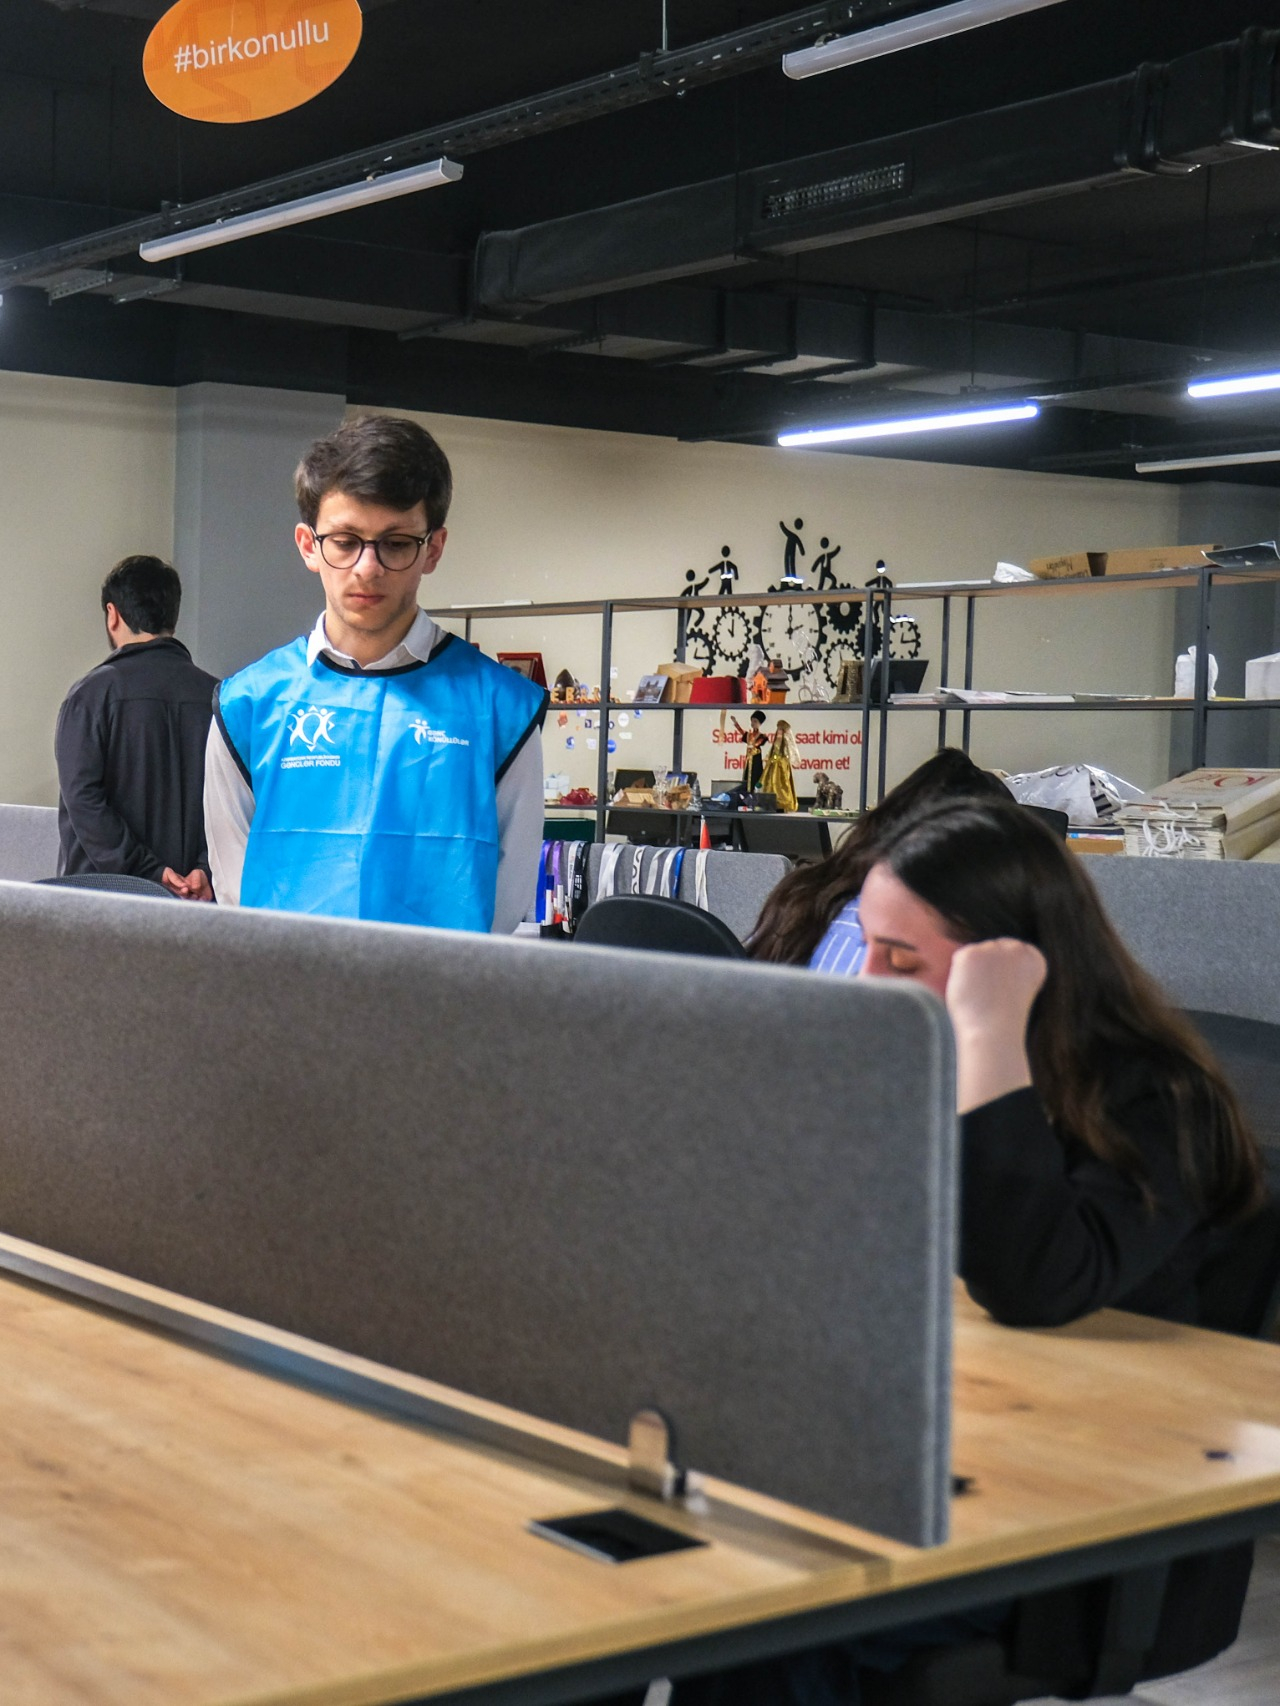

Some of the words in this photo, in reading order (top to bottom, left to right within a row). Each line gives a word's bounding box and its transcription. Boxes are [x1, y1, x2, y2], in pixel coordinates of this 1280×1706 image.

[173, 19, 329, 73] #birkonullu
[796, 732, 821, 744] saat
[823, 729, 848, 744] kimi
[792, 758, 833, 770] avam
